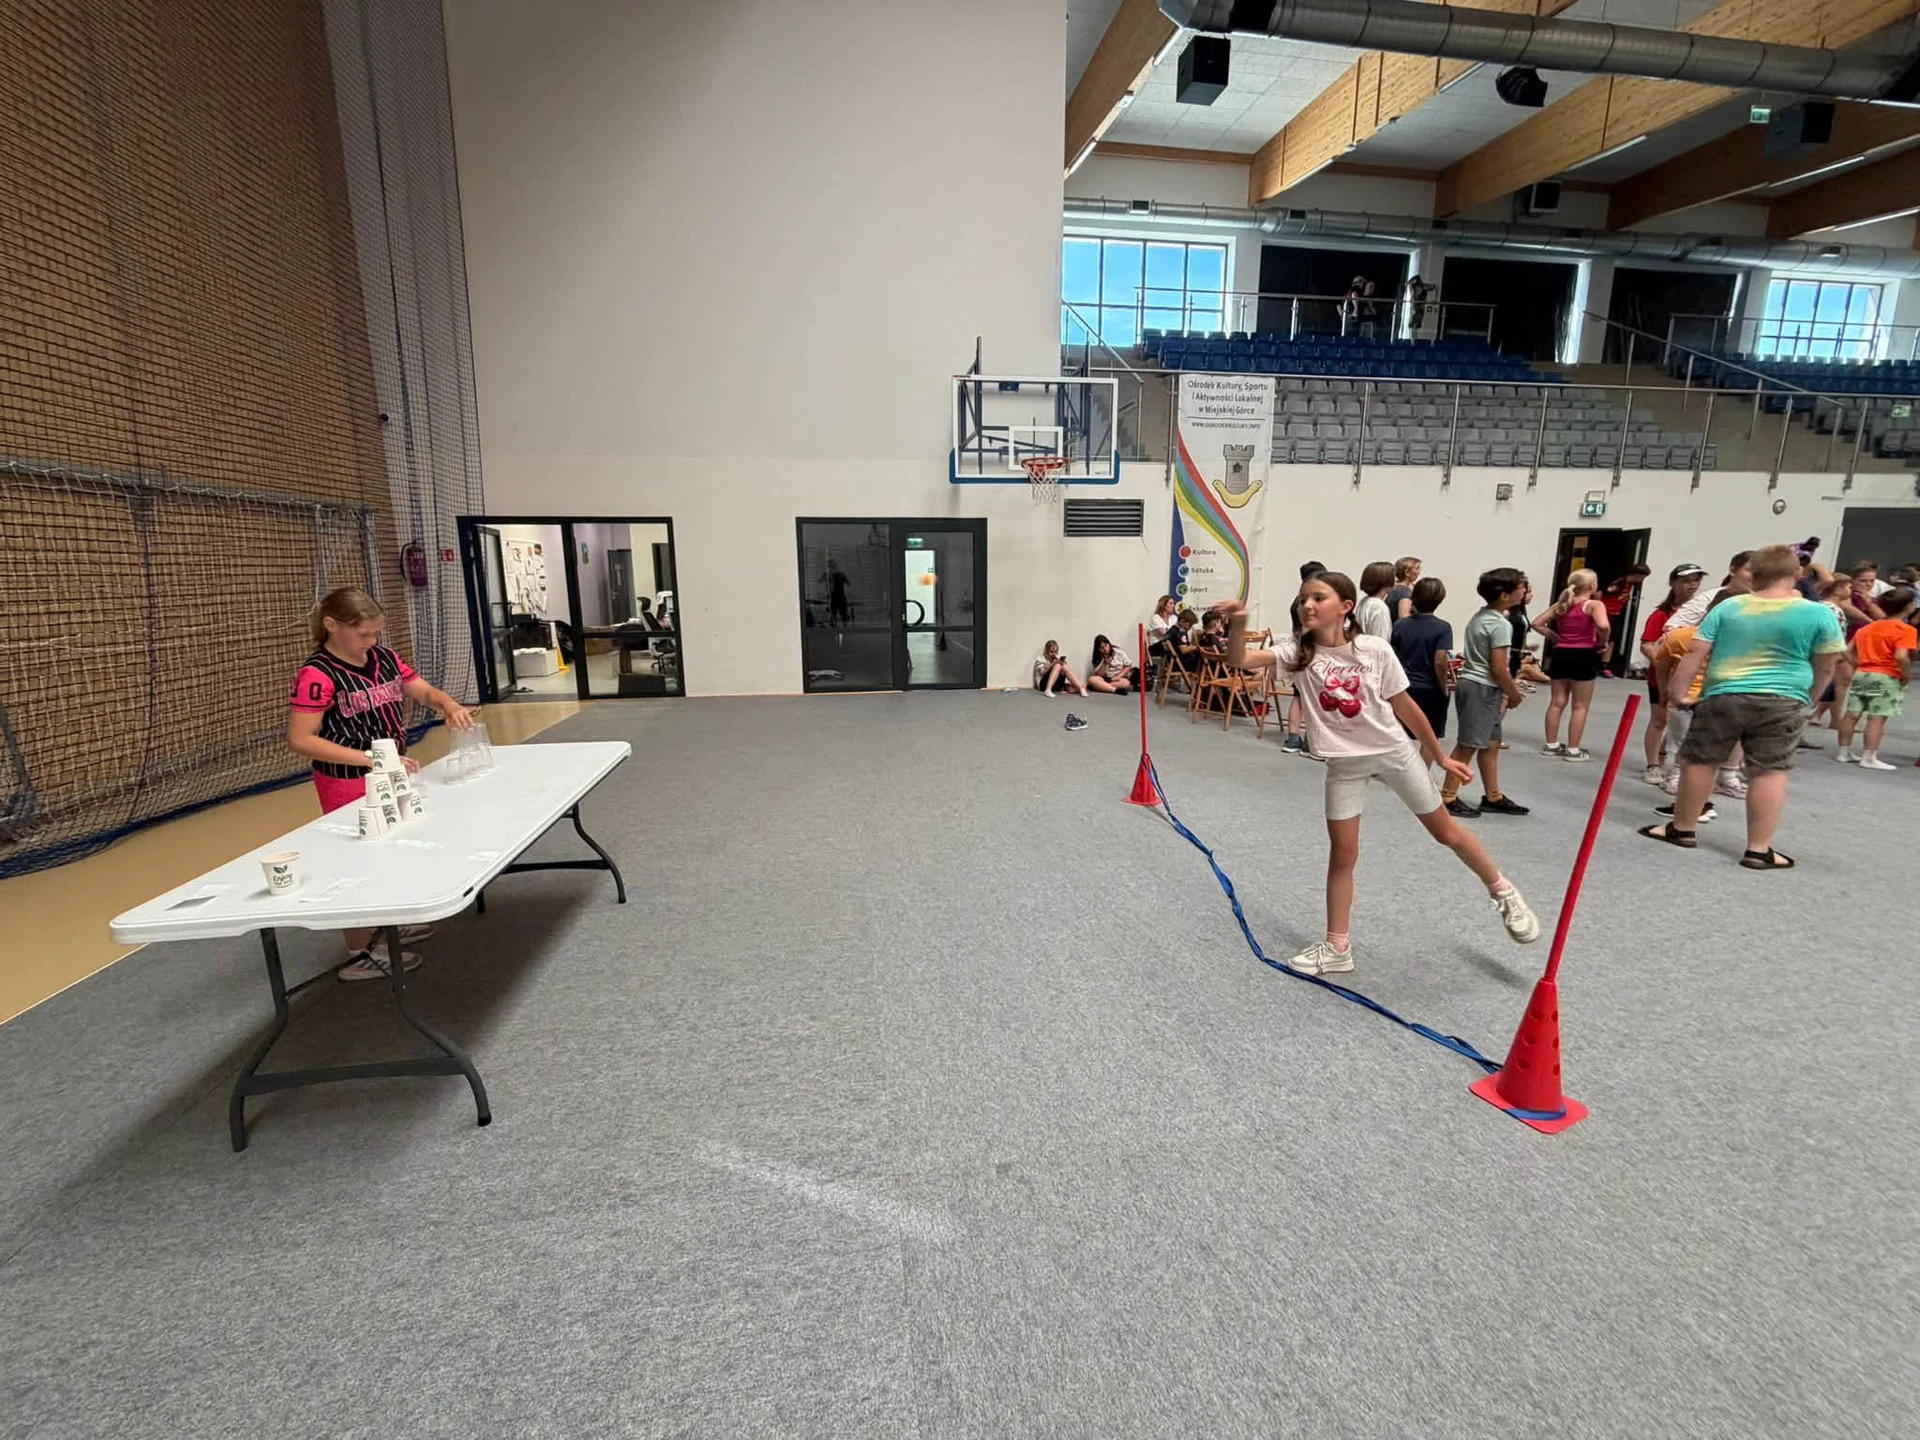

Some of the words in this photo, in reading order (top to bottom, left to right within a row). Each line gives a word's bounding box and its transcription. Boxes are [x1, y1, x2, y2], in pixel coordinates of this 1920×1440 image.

[1188, 380, 1215, 389] Ośrodek
[1216, 382, 1242, 392] Kultury,
[1244, 382, 1268, 391] Sportu
[1196, 392, 1234, 403] Aktywności
[1235, 394, 1264, 405] Lokalnej
[1205, 405, 1235, 416] Miejskiej
[1236, 405, 1255, 414] Górce
[1190, 586, 1208, 594] Sport
[1310, 660, 1373, 674] Cherries
